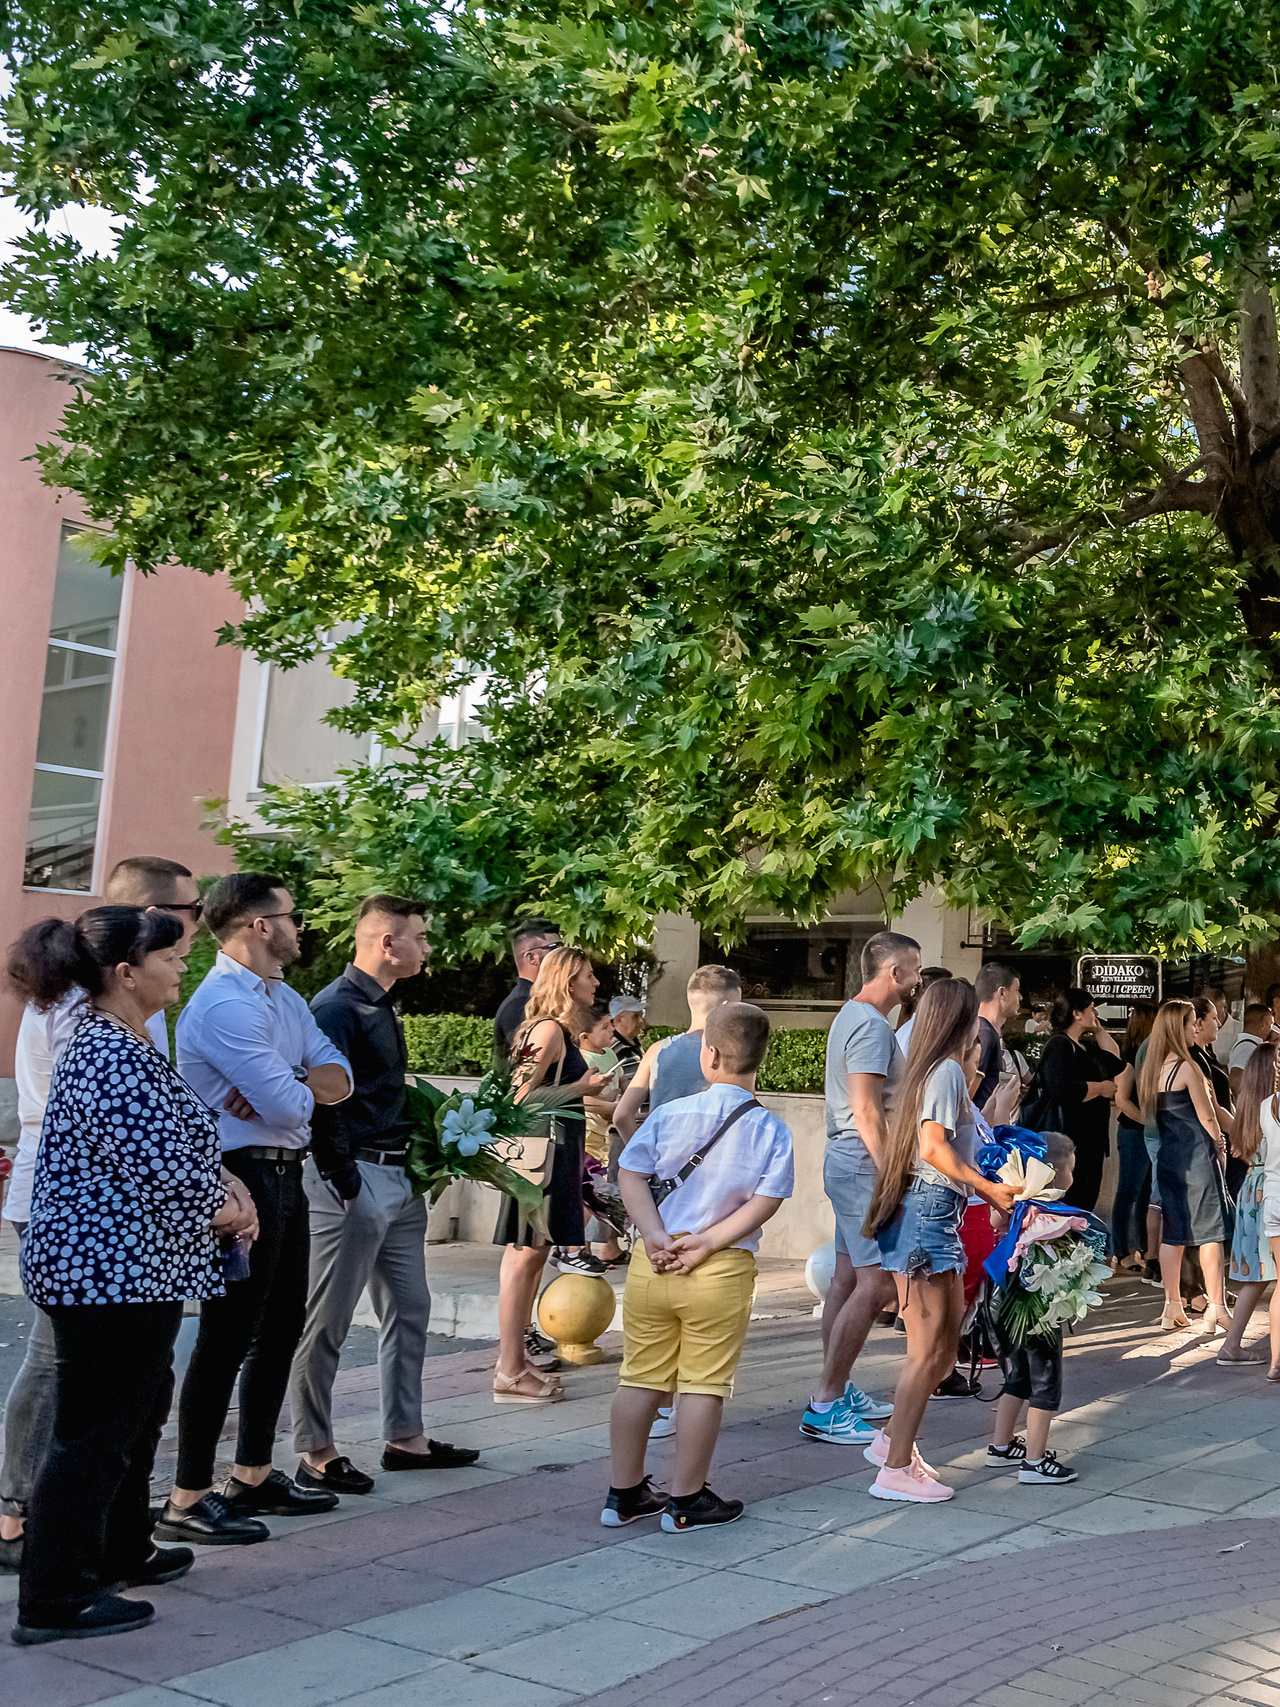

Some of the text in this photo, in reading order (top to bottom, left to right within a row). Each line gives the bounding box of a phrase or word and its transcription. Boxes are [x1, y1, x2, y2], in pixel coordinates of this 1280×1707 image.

[1095, 965, 1144, 976] DIDAKO
[1112, 985, 1120, 993] И
[1120, 985, 1155, 994] СРЕБРО
